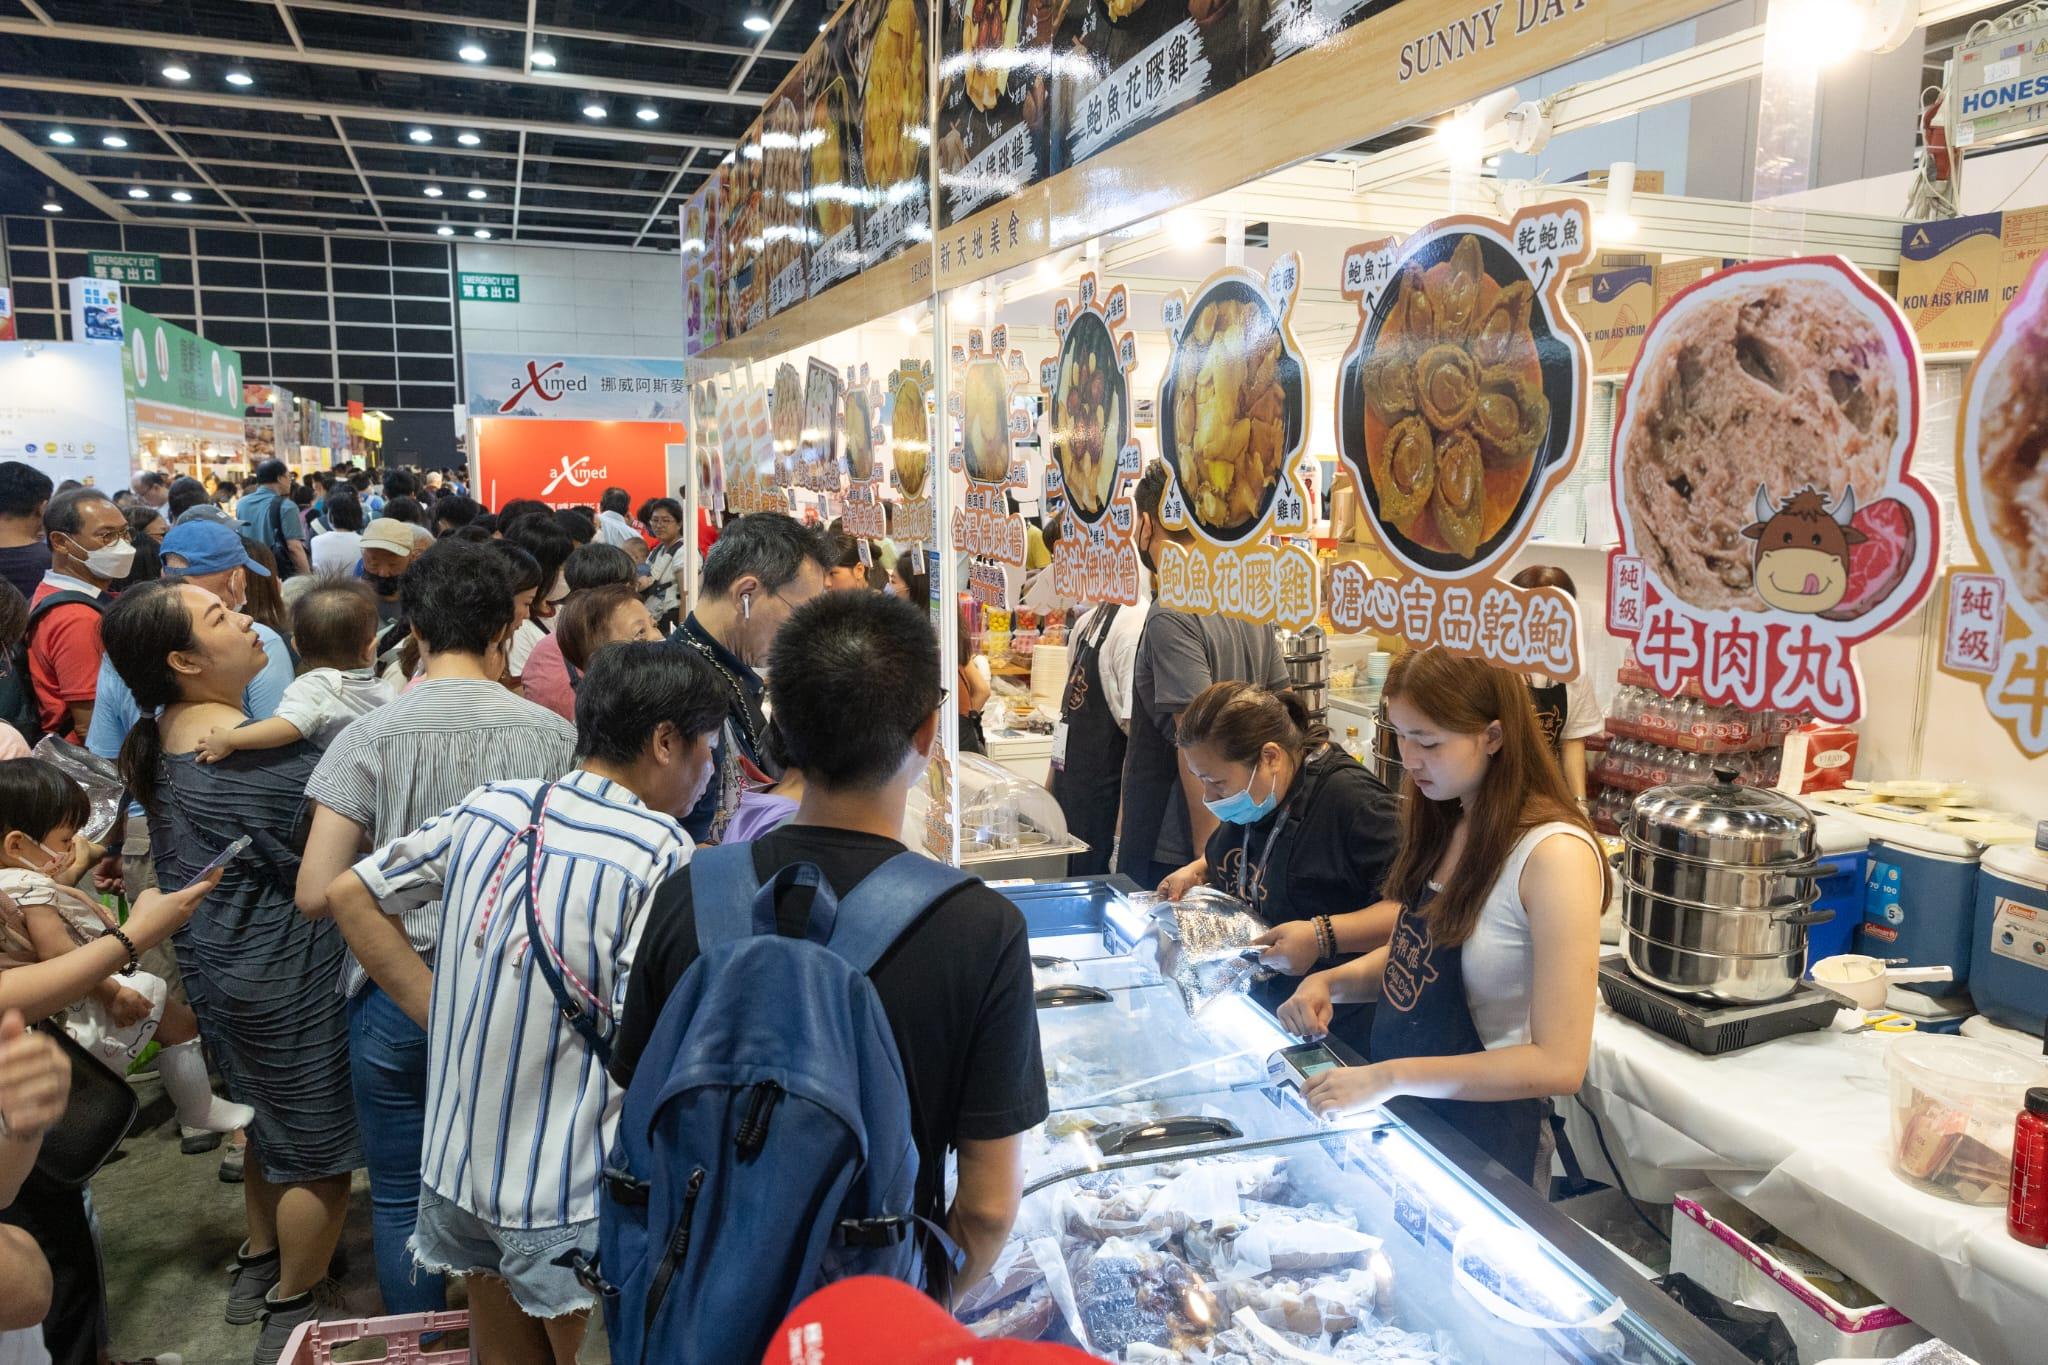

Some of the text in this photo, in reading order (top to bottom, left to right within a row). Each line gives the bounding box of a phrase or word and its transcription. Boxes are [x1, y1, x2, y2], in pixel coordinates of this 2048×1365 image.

[1399, 0, 1586, 81] SUNNY DA
[1085, 34, 1189, 142] 鮑魚花膠雞
[940, 209, 1019, 274] 新天地美食
[1517, 217, 1578, 256] 乾鮑魚
[93, 255, 155, 267] EMERGENCY EXIT
[94, 266, 156, 281] 緊急出口
[463, 275, 516, 285] EMERGENCY EXIT
[1347, 254, 1392, 286] 鮑魚汁
[463, 284, 516, 299] 緊急出口
[1903, 288, 1989, 310] KON AIS KRIM
[1595, 328, 1610, 341] KON
[1611, 327, 1624, 338] AIS
[1625, 324, 1646, 337] KRIM
[541, 455, 607, 496] aXimed
[1277, 499, 1301, 521] 雞肉
[953, 515, 1023, 562] 金湯佛跳牆
[1055, 547, 1137, 602] 鮑汁佛跳牆
[1160, 549, 1311, 621] 鮑魚花膠雞
[1619, 564, 1640, 623] 純級
[1332, 567, 1571, 671] 溏心吉品乾鮑
[1958, 586, 1993, 662] 純級
[1642, 606, 1849, 709] 牛肉丸
[1883, 885, 1897, 895] 100
[1888, 909, 1896, 919] 5
